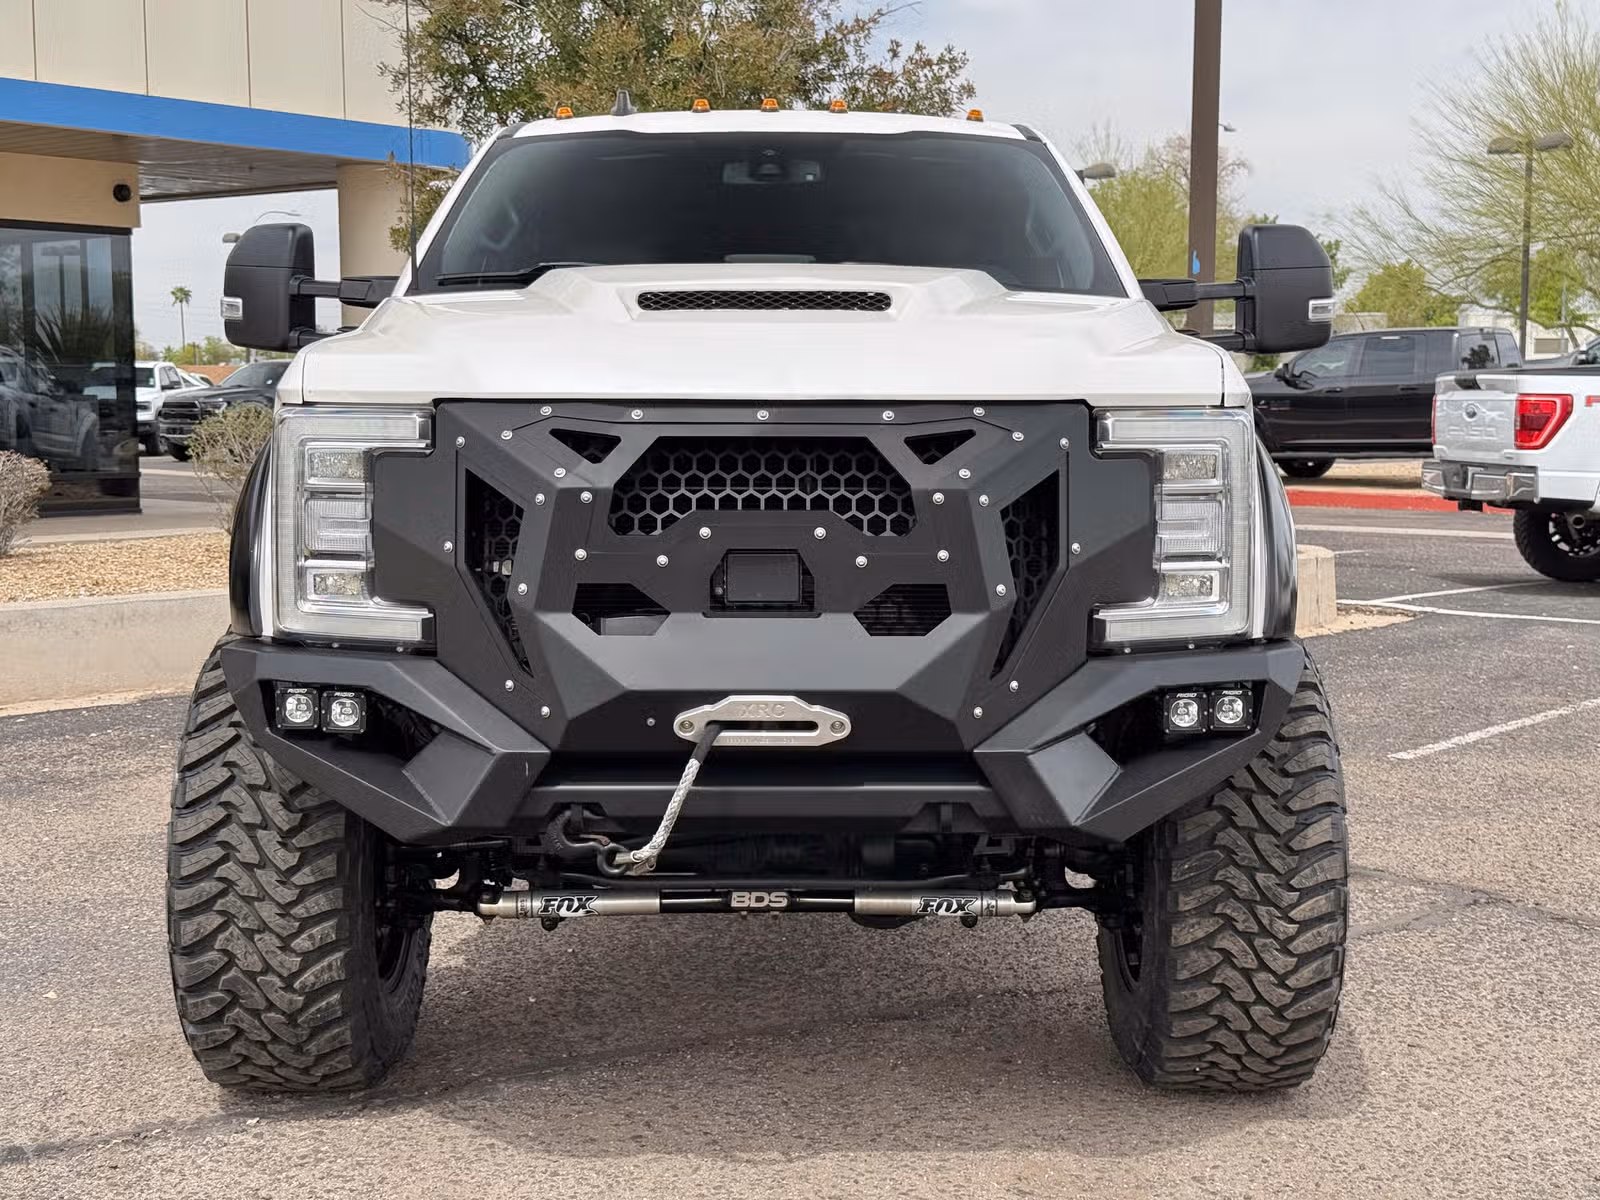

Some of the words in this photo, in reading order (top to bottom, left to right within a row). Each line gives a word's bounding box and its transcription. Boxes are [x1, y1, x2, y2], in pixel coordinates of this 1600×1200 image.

[740, 703, 786, 718] XRC
[538, 896, 598, 917] FOX
[731, 891, 789, 907] BDS
[917, 897, 976, 917] FOX
